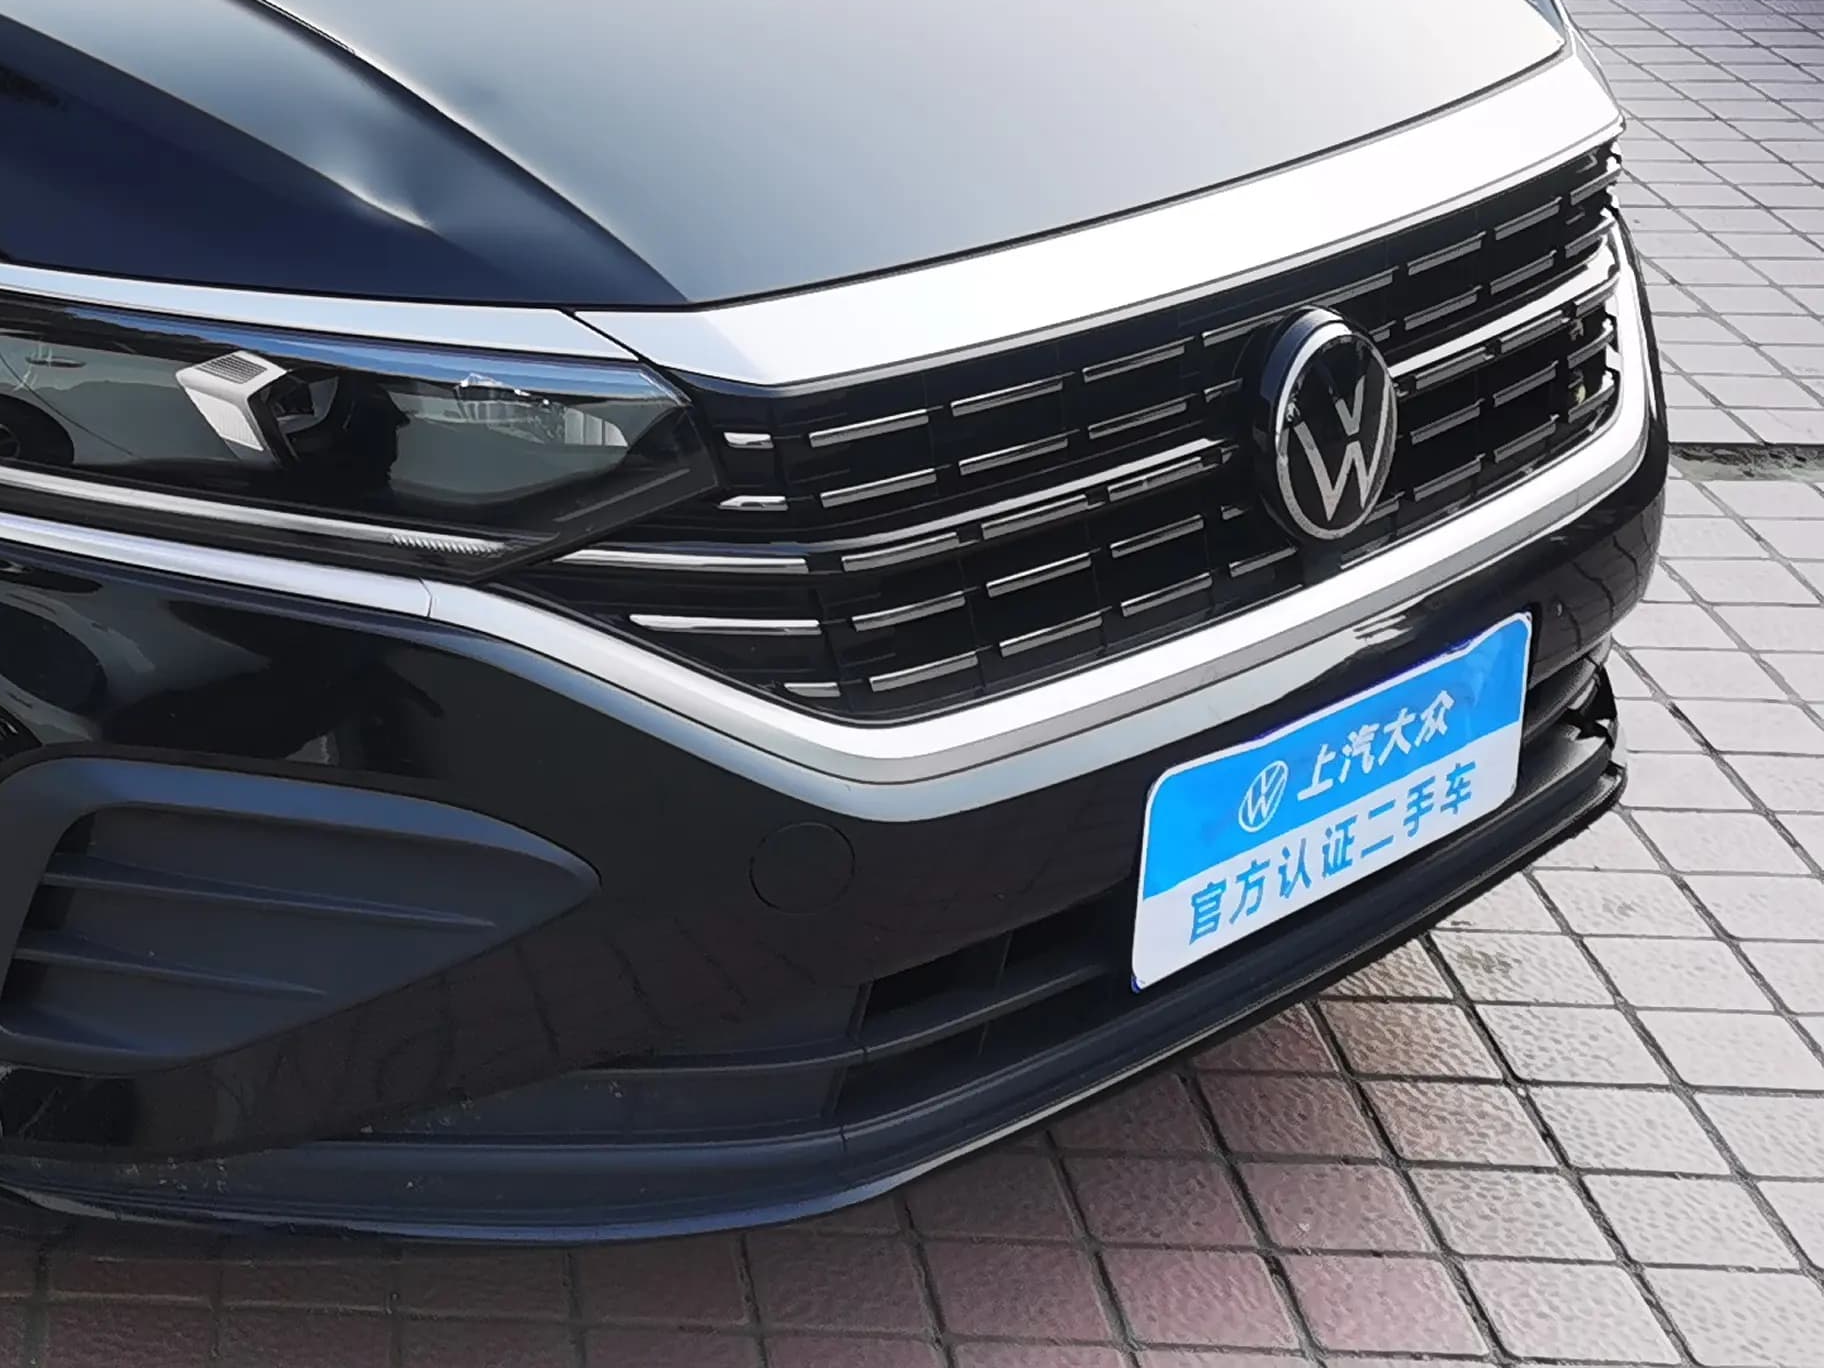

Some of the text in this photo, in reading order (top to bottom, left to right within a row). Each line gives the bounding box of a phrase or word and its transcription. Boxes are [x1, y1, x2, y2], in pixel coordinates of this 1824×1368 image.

[1296, 690, 1455, 802] 上汽大众
[1189, 761, 1477, 946] 官方认证二手车
